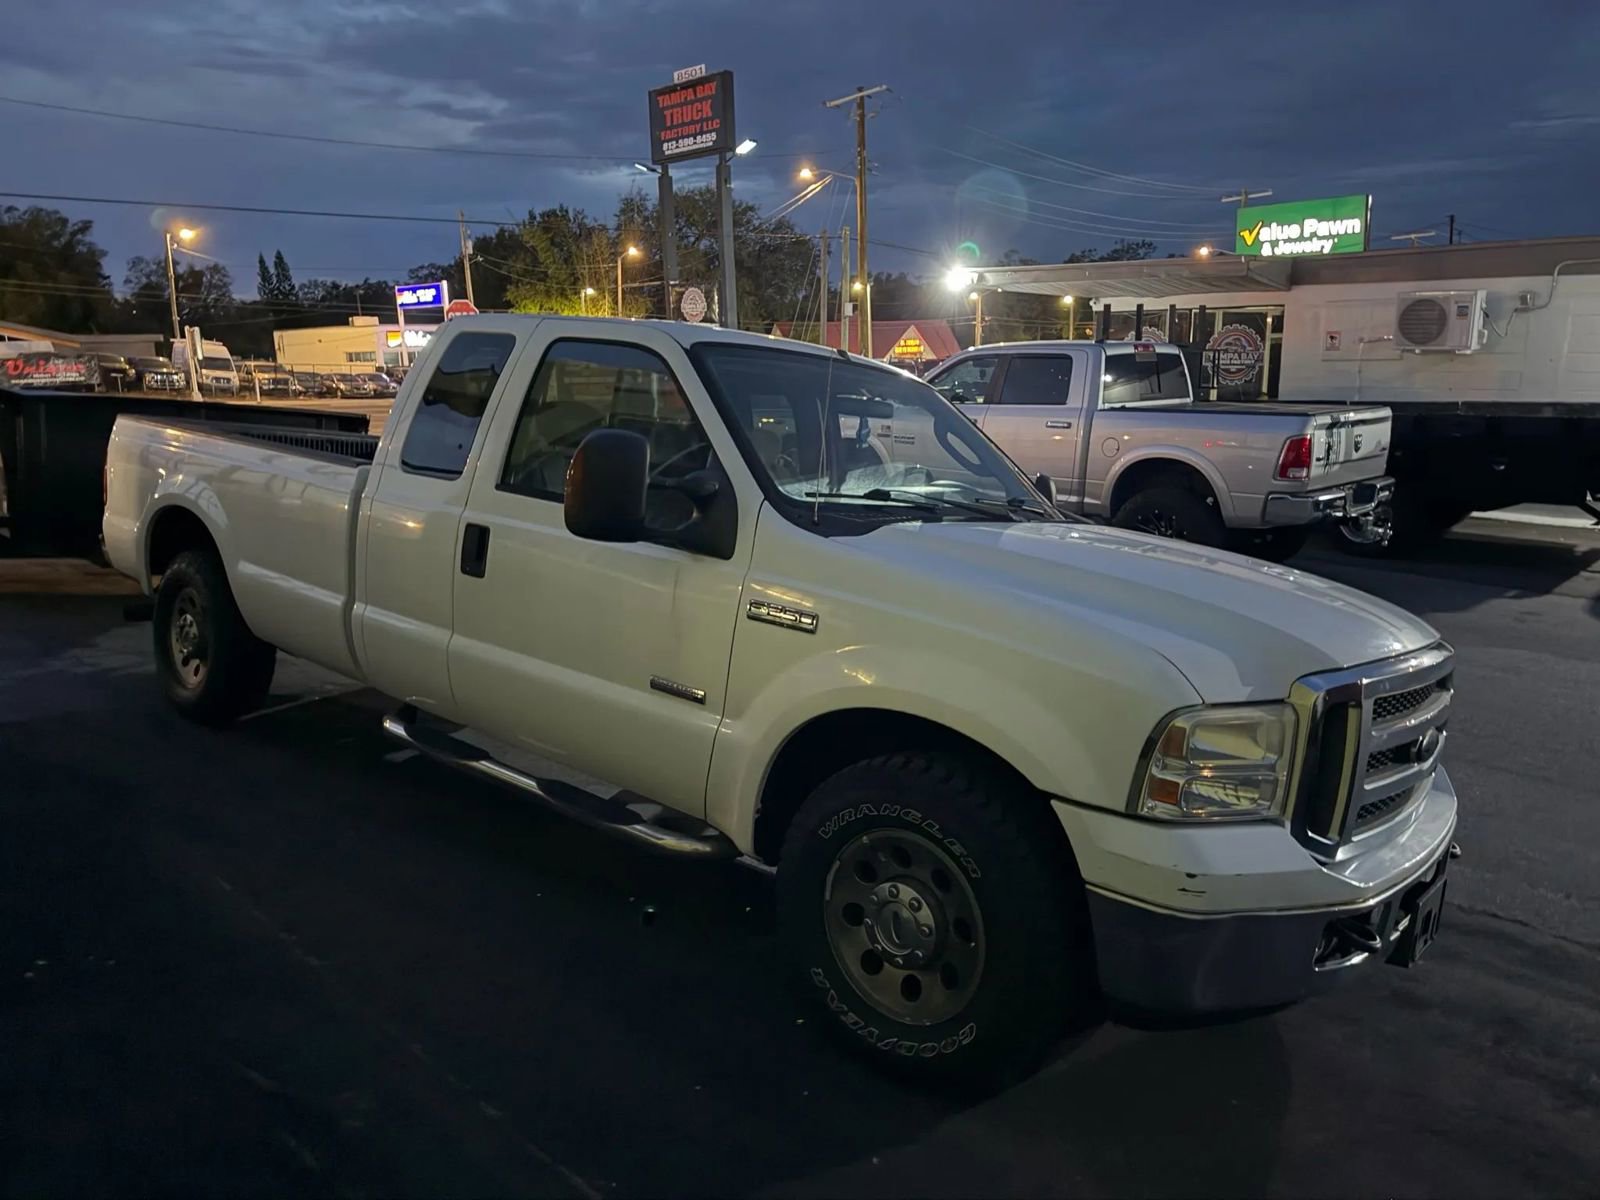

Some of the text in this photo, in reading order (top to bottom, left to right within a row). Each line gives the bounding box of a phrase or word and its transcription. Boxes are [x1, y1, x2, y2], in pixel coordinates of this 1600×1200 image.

[676, 66, 705, 81] 8501
[657, 81, 717, 108] TAMPA BAY
[664, 99, 713, 127] TRUCK
[660, 118, 721, 140] FACTORY LLC
[1240, 218, 1361, 246] Value Pawn
[1260, 237, 1334, 257] & Jewelry
[818, 803, 981, 879] WRANGLER
[810, 967, 977, 1057] GOODYEAR
